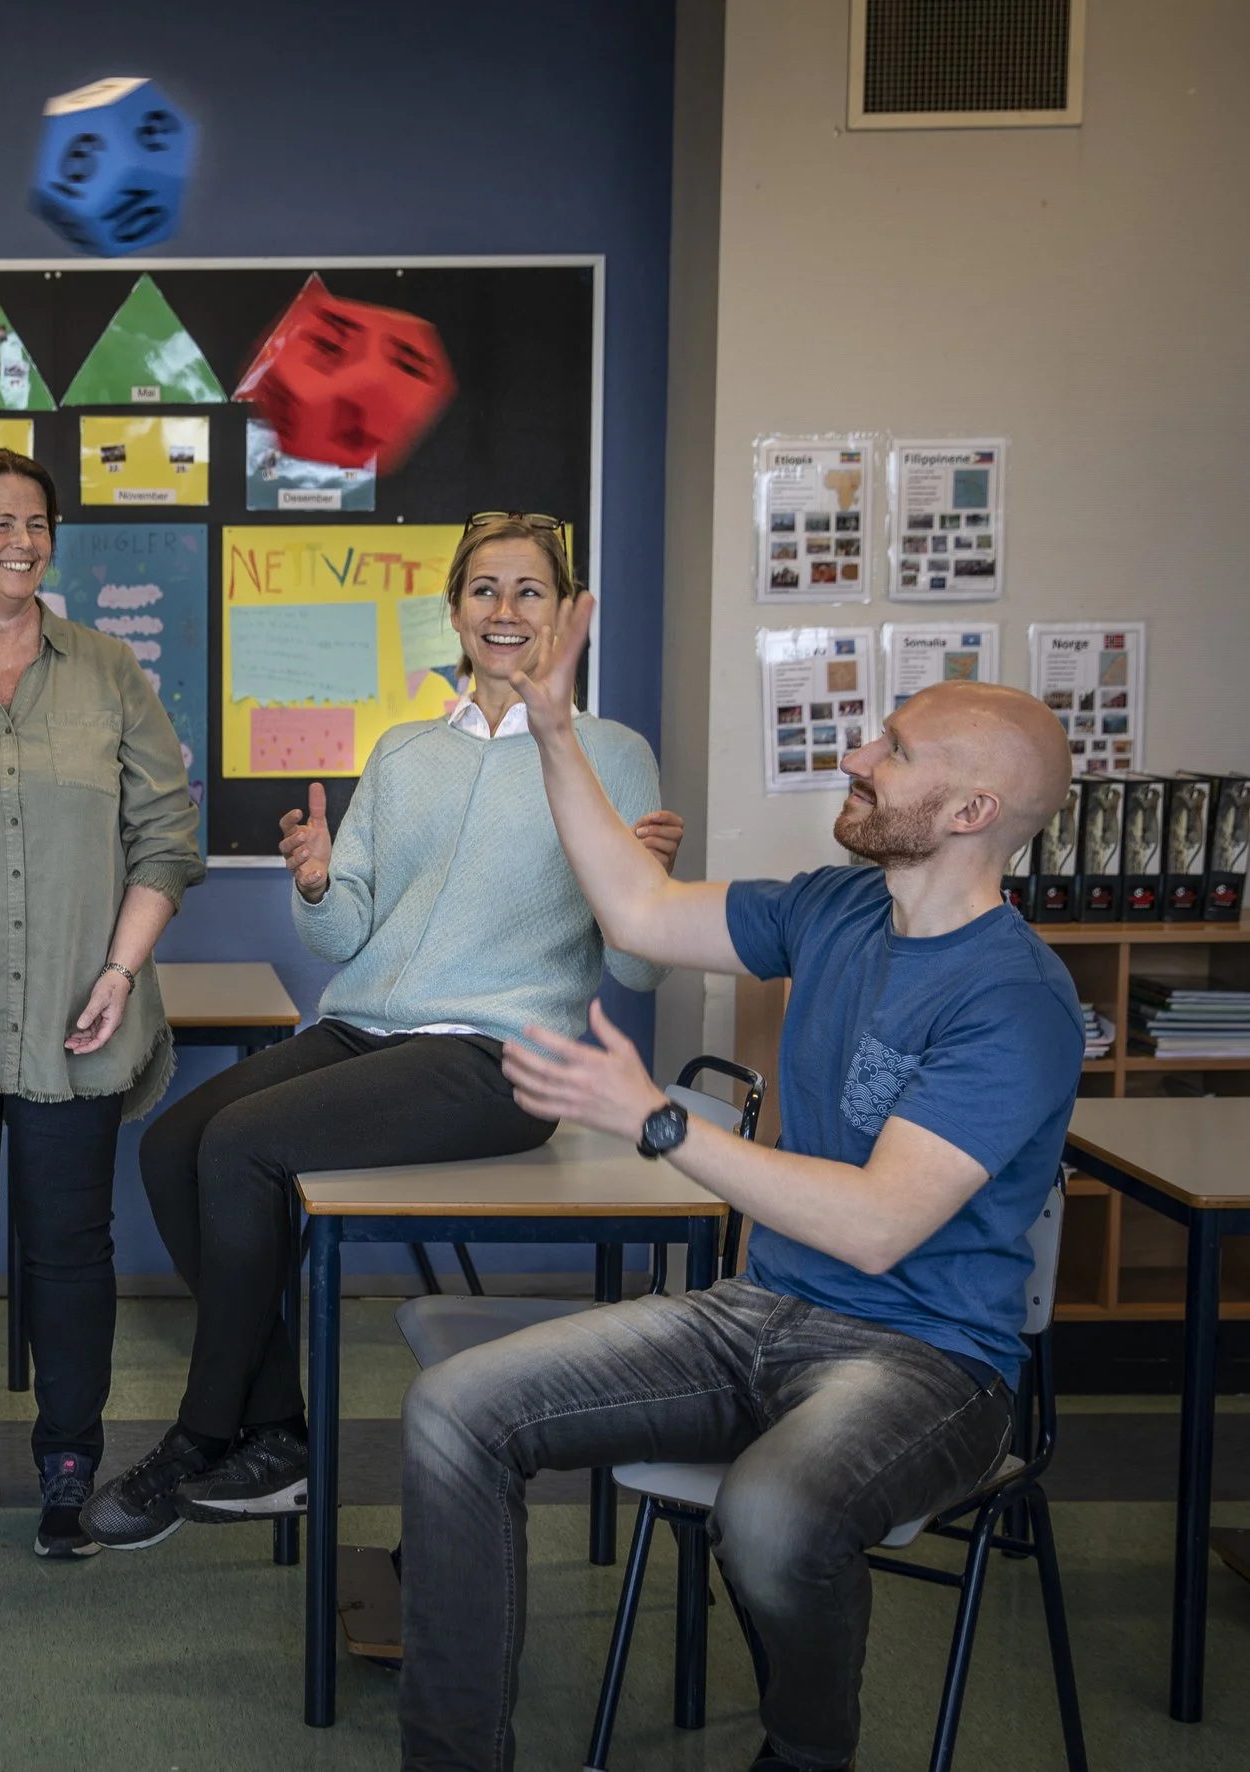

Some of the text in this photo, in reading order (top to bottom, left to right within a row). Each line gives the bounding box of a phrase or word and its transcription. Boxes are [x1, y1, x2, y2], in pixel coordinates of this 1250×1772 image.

[904, 453, 971, 467] Filippinene
[119, 491, 168, 500] November
[903, 637, 947, 648] Somalia
[1052, 638, 1091, 652] Norge
